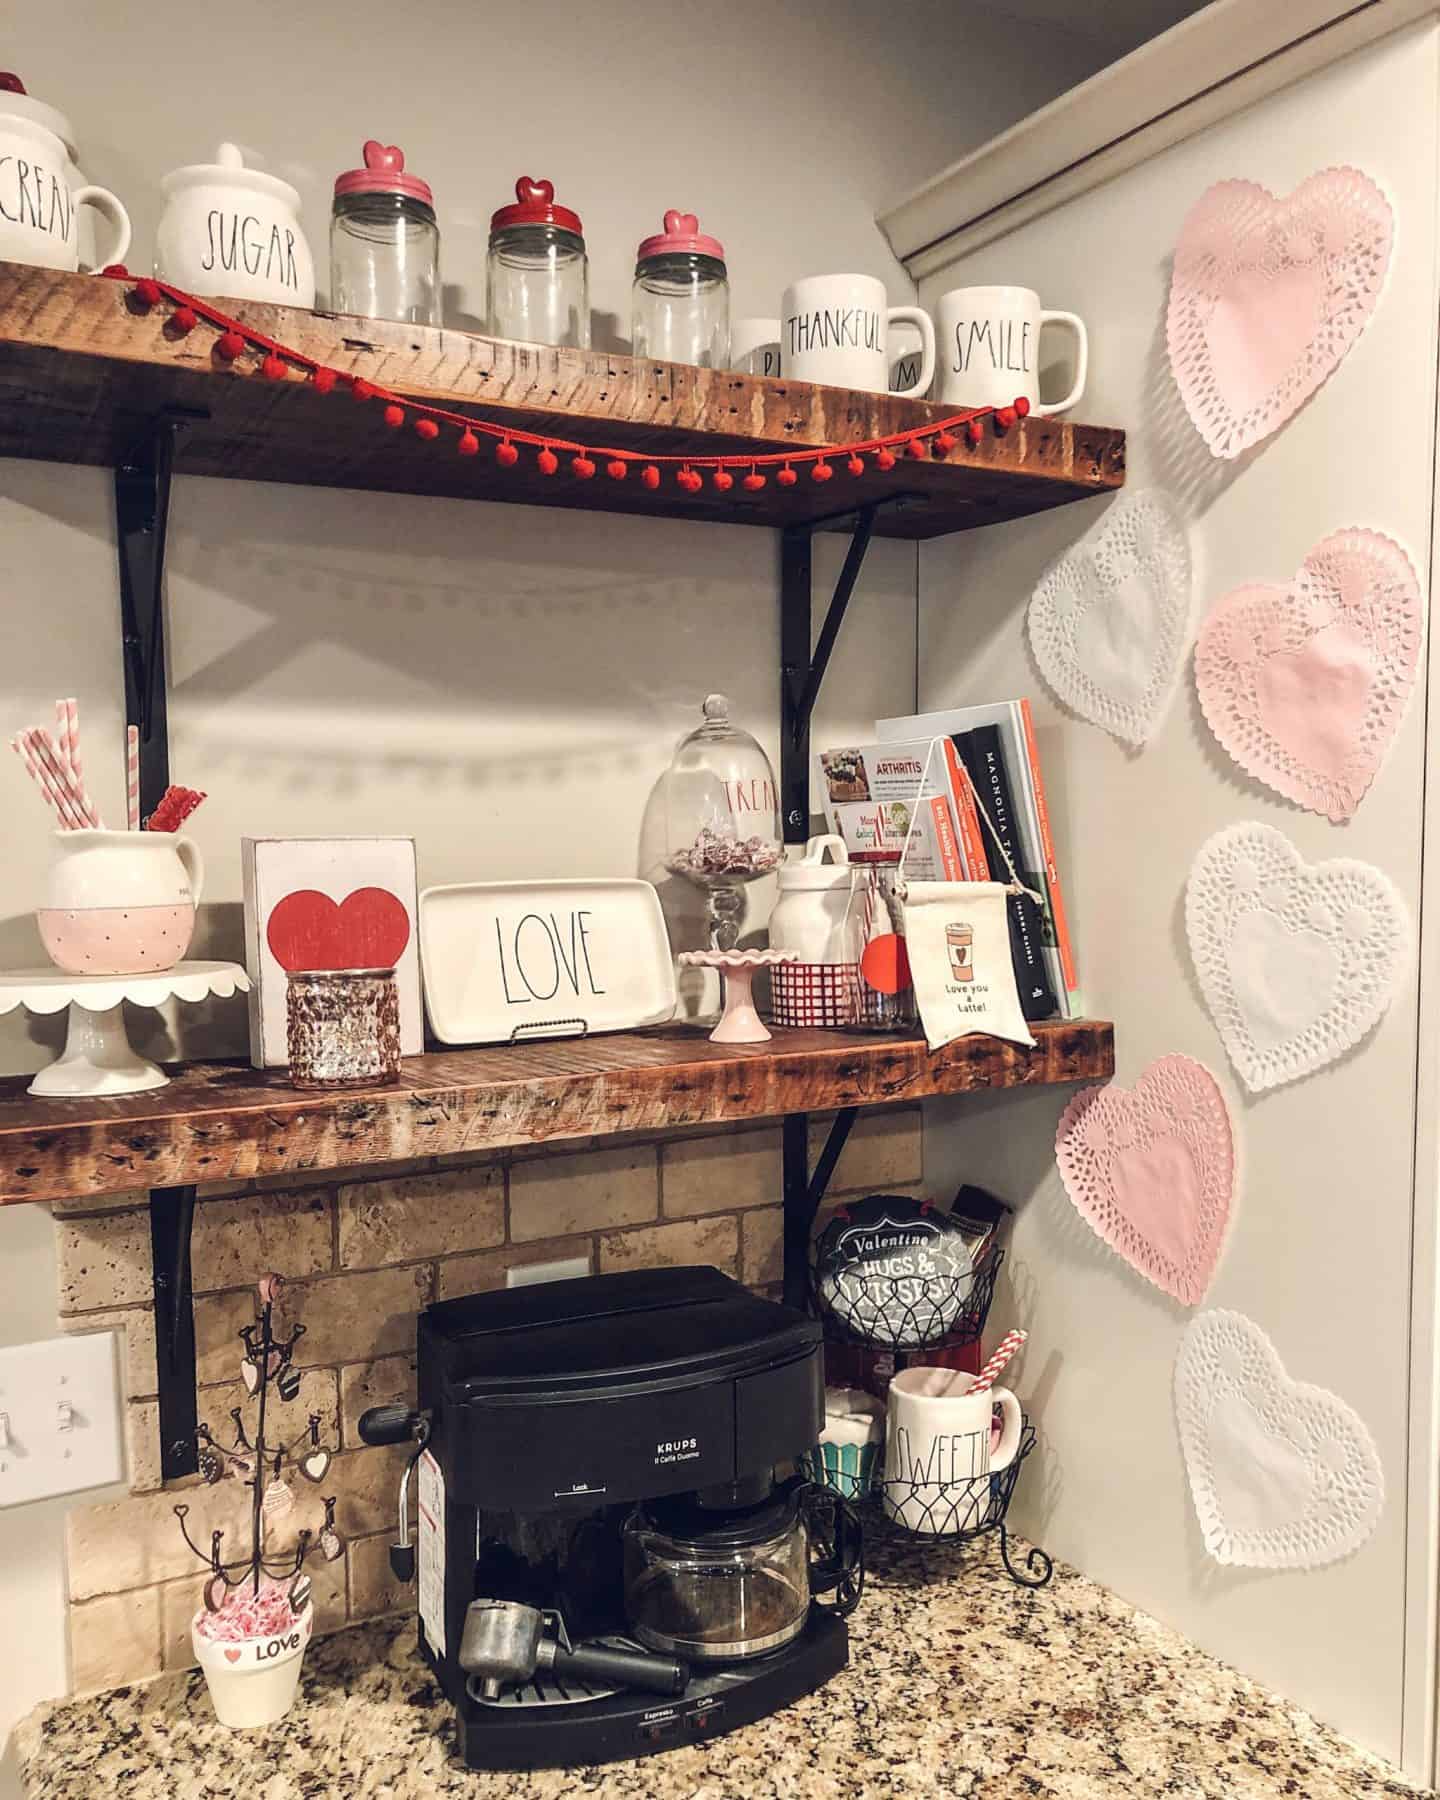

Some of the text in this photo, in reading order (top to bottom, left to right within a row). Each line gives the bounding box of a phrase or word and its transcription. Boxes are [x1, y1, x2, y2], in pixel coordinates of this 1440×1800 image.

[202, 210, 298, 290] SUGAR
[787, 308, 883, 357] THANKFUL
[952, 319, 1031, 373] SMILE
[876, 761, 922, 775] ARTHRITIS
[985, 751, 1008, 833] MAGNOLIA
[495, 910, 606, 1004] LOVE
[945, 984, 989, 995] Love you
[853, 1232, 930, 1254] Valentine
[862, 1255, 915, 1277] HUGS
[657, 1437, 697, 1455] KRUPS
